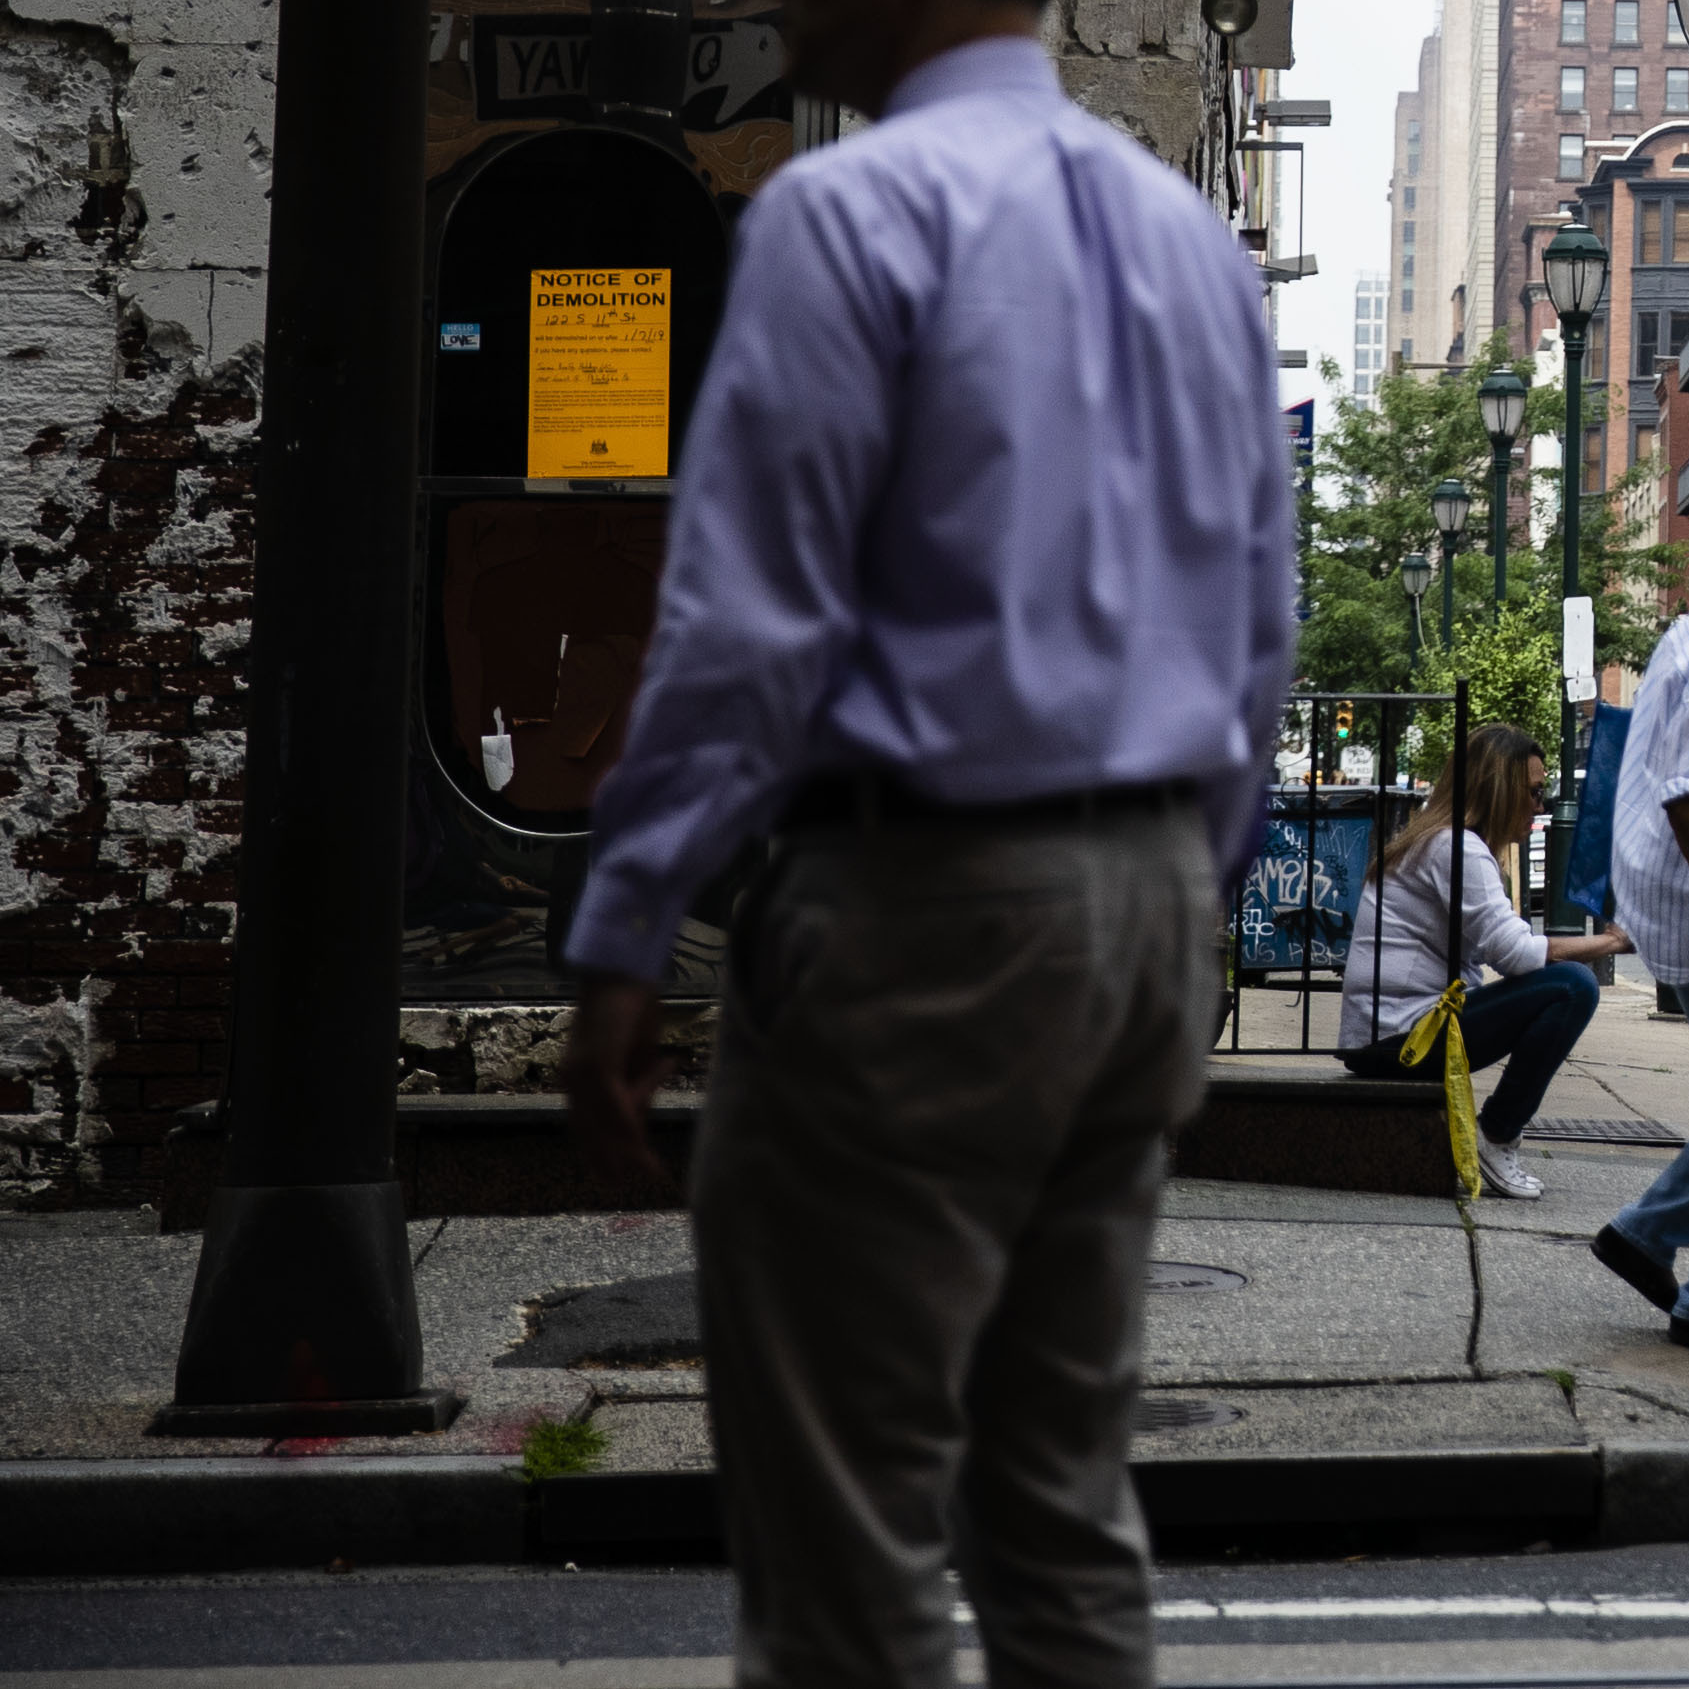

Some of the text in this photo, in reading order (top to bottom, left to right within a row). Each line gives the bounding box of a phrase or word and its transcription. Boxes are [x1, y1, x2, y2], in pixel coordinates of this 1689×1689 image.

[541, 272, 662, 287] NOTICE OF
[537, 292, 665, 307] DEMOLITION
[545, 314, 569, 326] 122
[576, 313, 585, 325] S
[620, 311, 636, 323] St
[441, 334, 478, 347] LOVE
